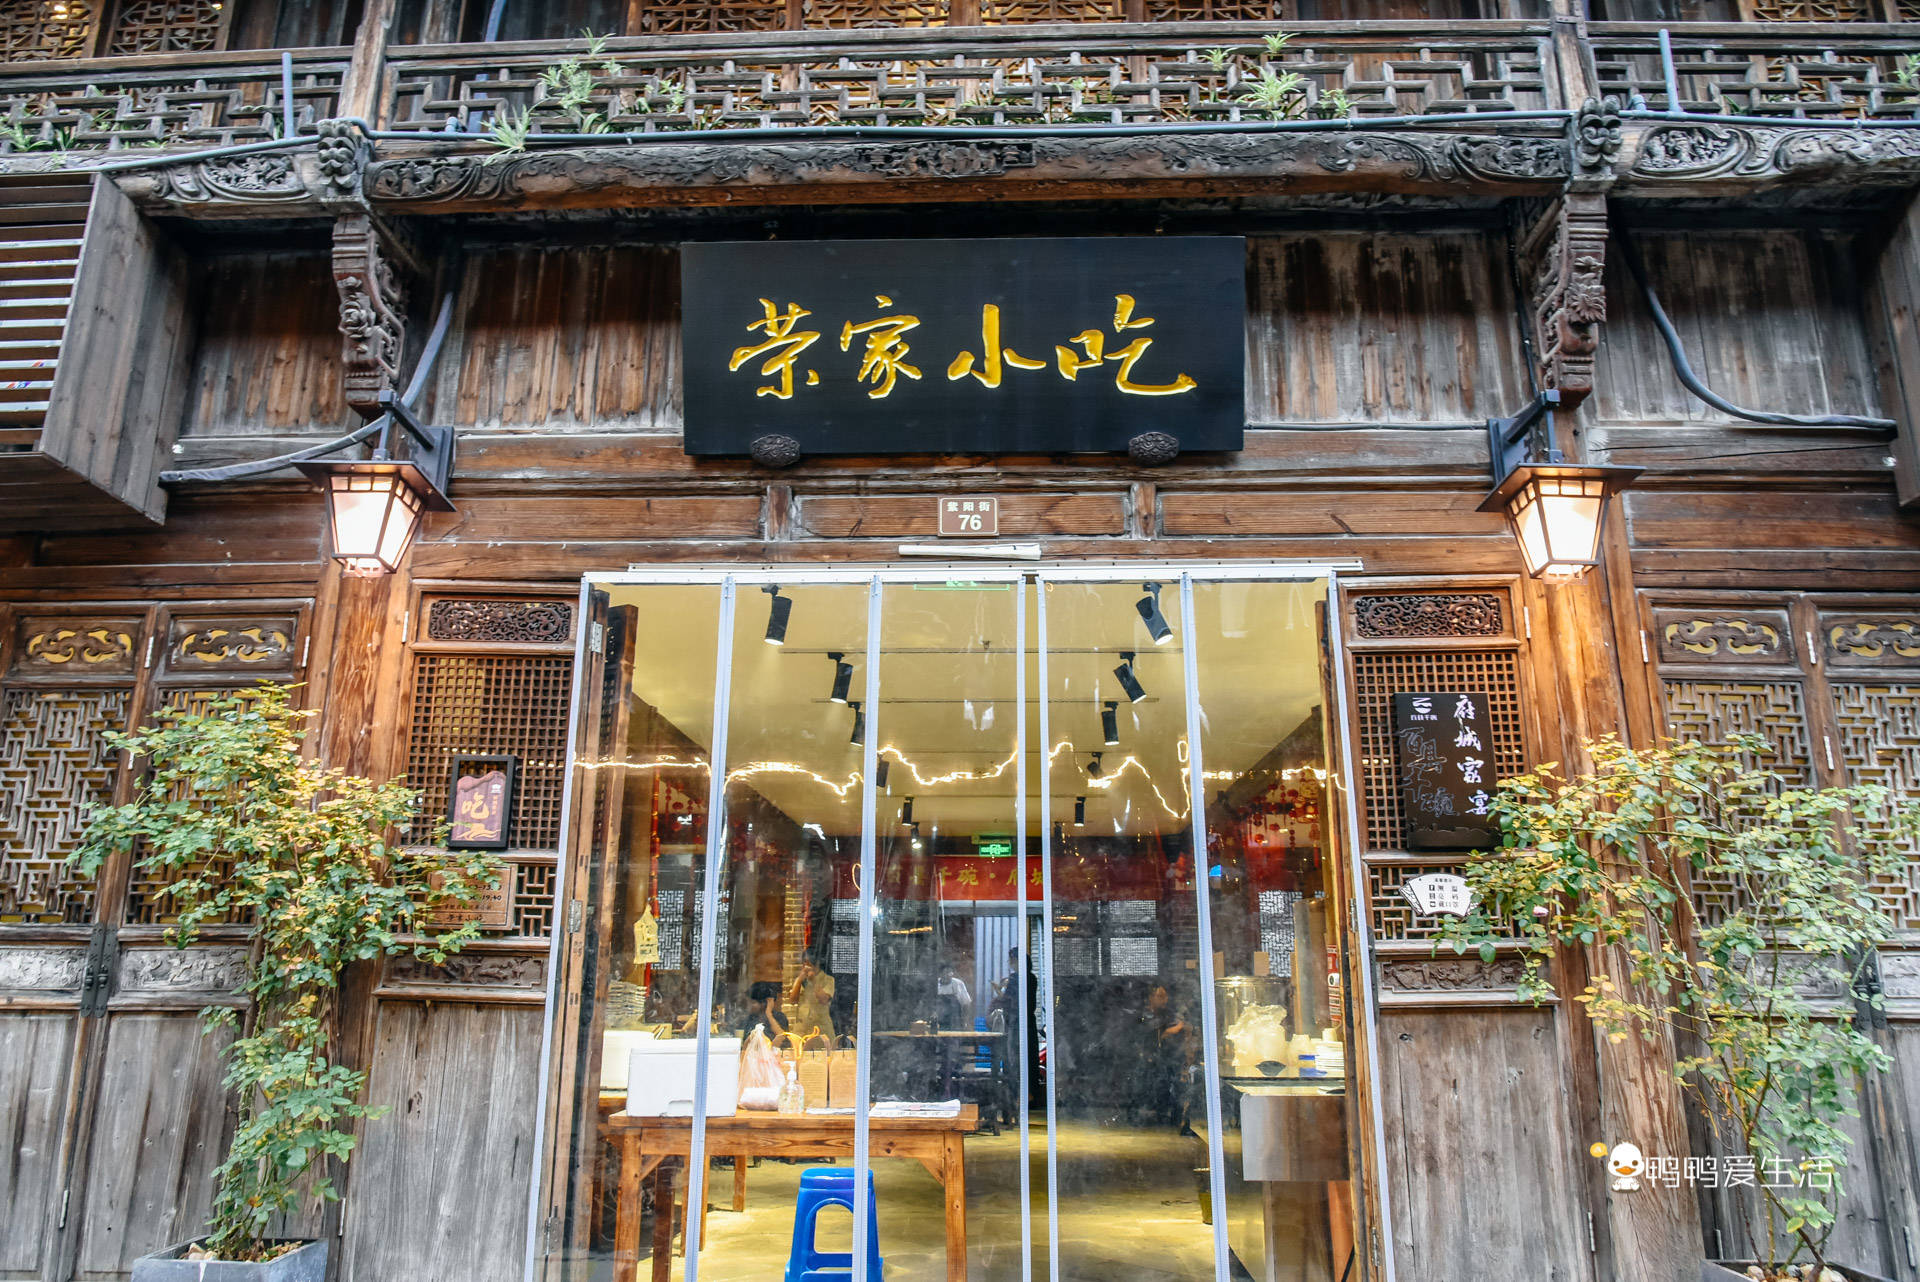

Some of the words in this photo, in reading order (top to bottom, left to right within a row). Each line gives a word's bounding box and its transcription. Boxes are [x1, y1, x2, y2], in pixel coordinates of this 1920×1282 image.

[728, 293, 1198, 400] 荣家小吃
[946, 501, 991, 512] 紫阳街
[958, 514, 983, 531] 76
[1453, 694, 1489, 816] 府城家宴
